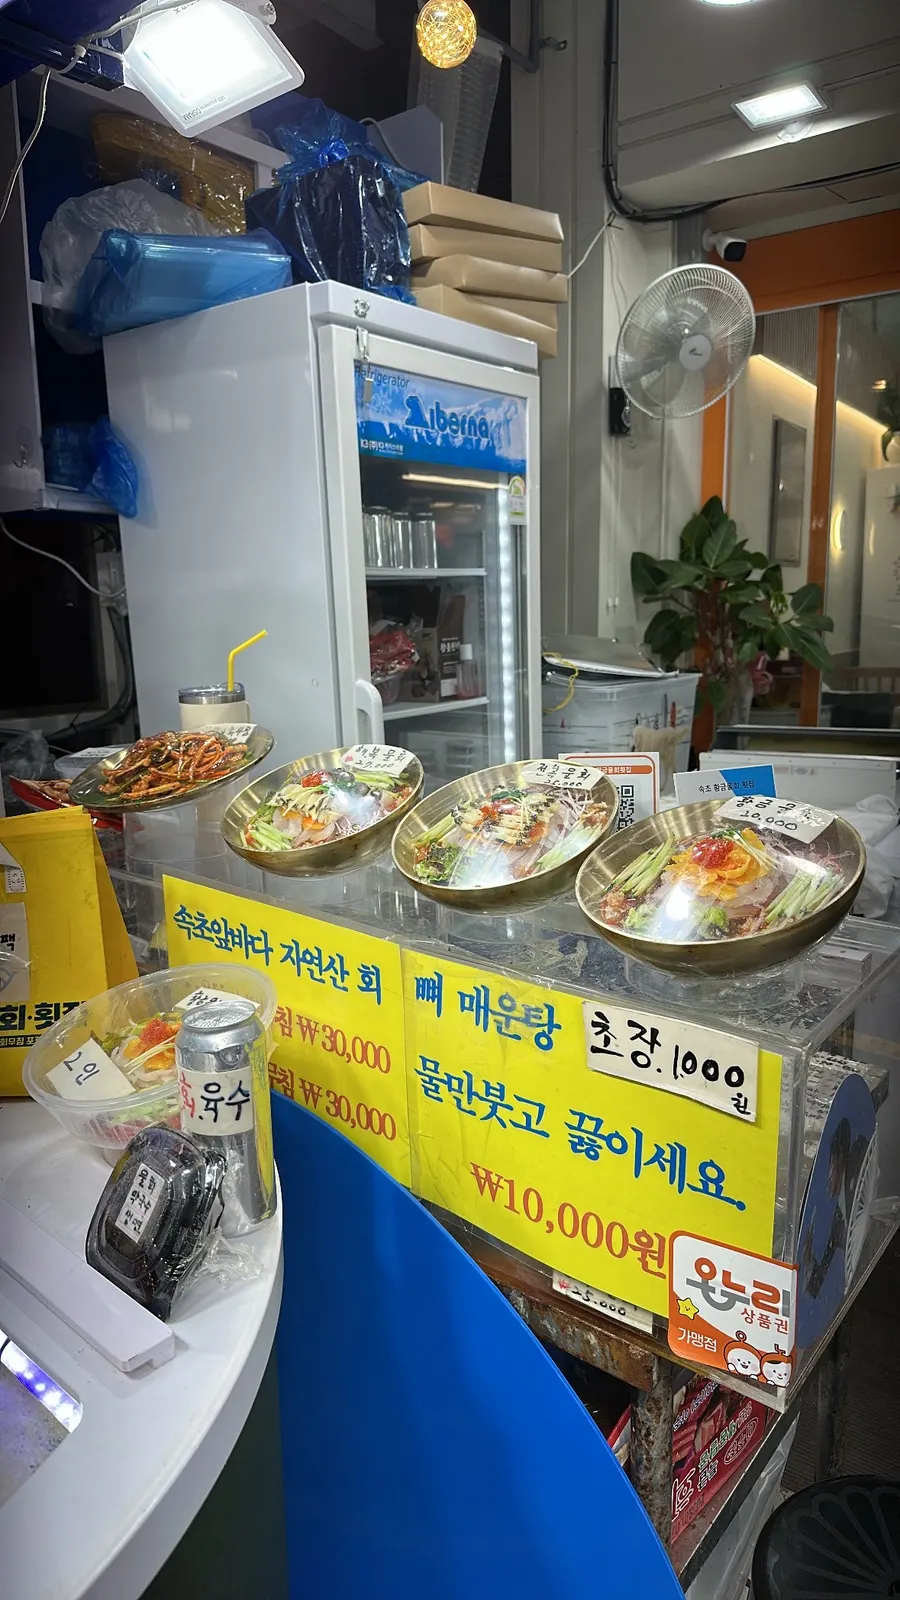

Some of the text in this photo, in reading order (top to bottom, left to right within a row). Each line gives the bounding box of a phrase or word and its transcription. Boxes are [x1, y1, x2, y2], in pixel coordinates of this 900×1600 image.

[354, 366, 410, 389] Refrigerator
[698, 784, 711, 793] 속초
[172, 904, 382, 1006] 속초앞바다 자연산 회
[414, 971, 563, 1052] 뼈 매운탕
[414, 1054, 551, 1139] 물만붓고
[730, 1092, 751, 1115] 원
[129, 1189, 152, 1215] 막국수
[685, 1256, 791, 1318] 온누리
[741, 1307, 789, 1335] 상품권
[677, 1326, 717, 1353] 가맹점
